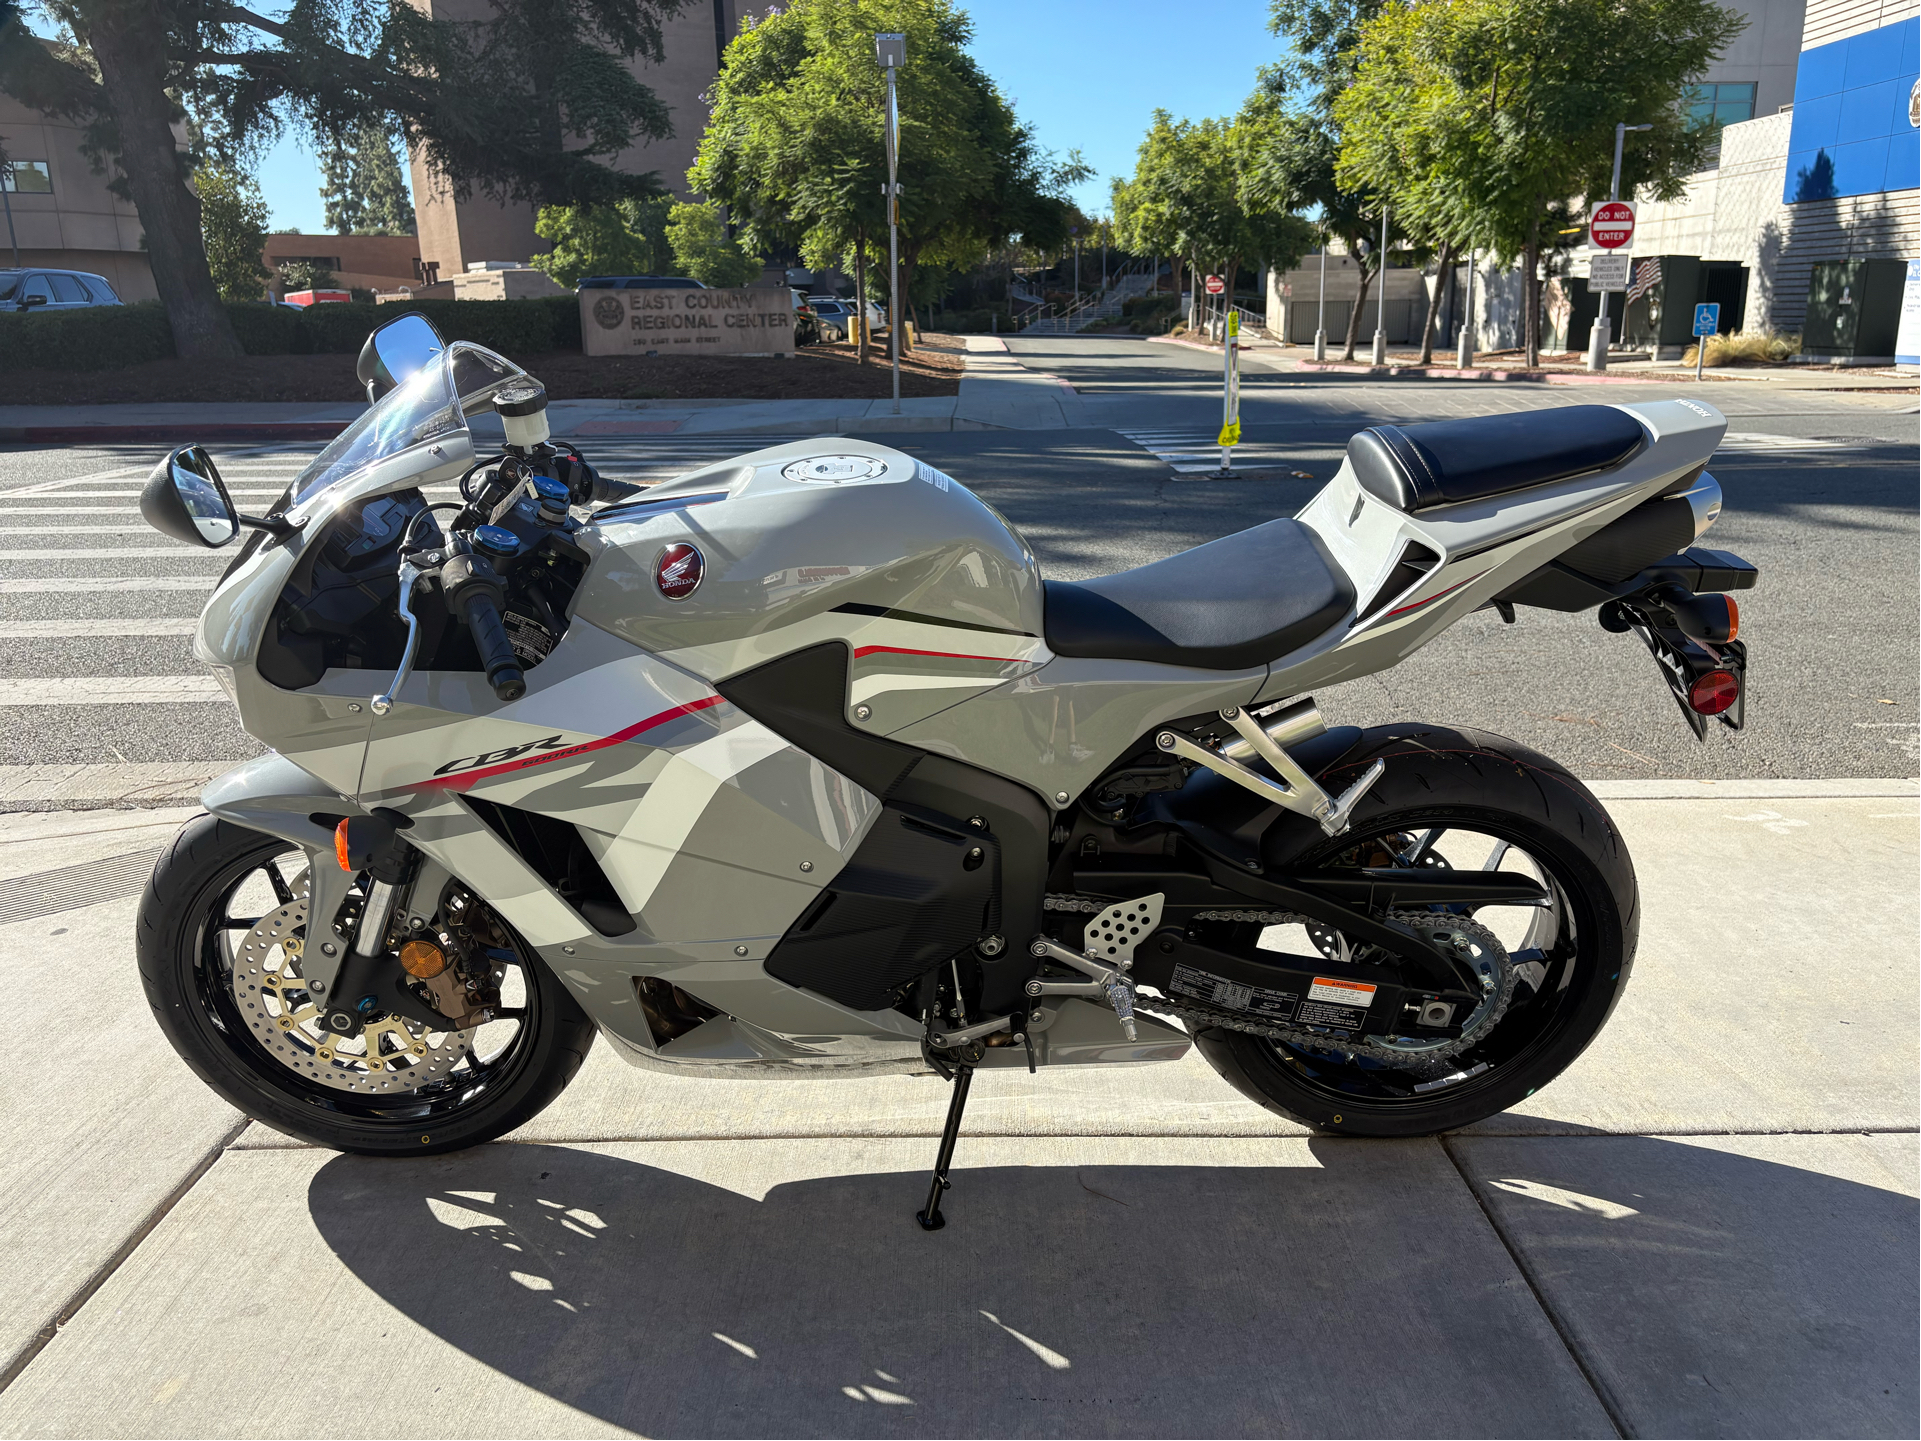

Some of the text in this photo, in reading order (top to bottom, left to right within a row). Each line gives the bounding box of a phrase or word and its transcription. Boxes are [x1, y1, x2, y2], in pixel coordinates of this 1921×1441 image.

[1598, 211, 1630, 220] DO NOT
[1598, 232, 1625, 240] ENTER
[629, 294, 755, 310] EAST COUNTY
[631, 312, 789, 330] REGIONAL CENTER
[695, 336, 721, 344] STREET
[661, 577, 696, 590] HONDA
[433, 734, 575, 777] CBR
[521, 745, 590, 767] 600RR
